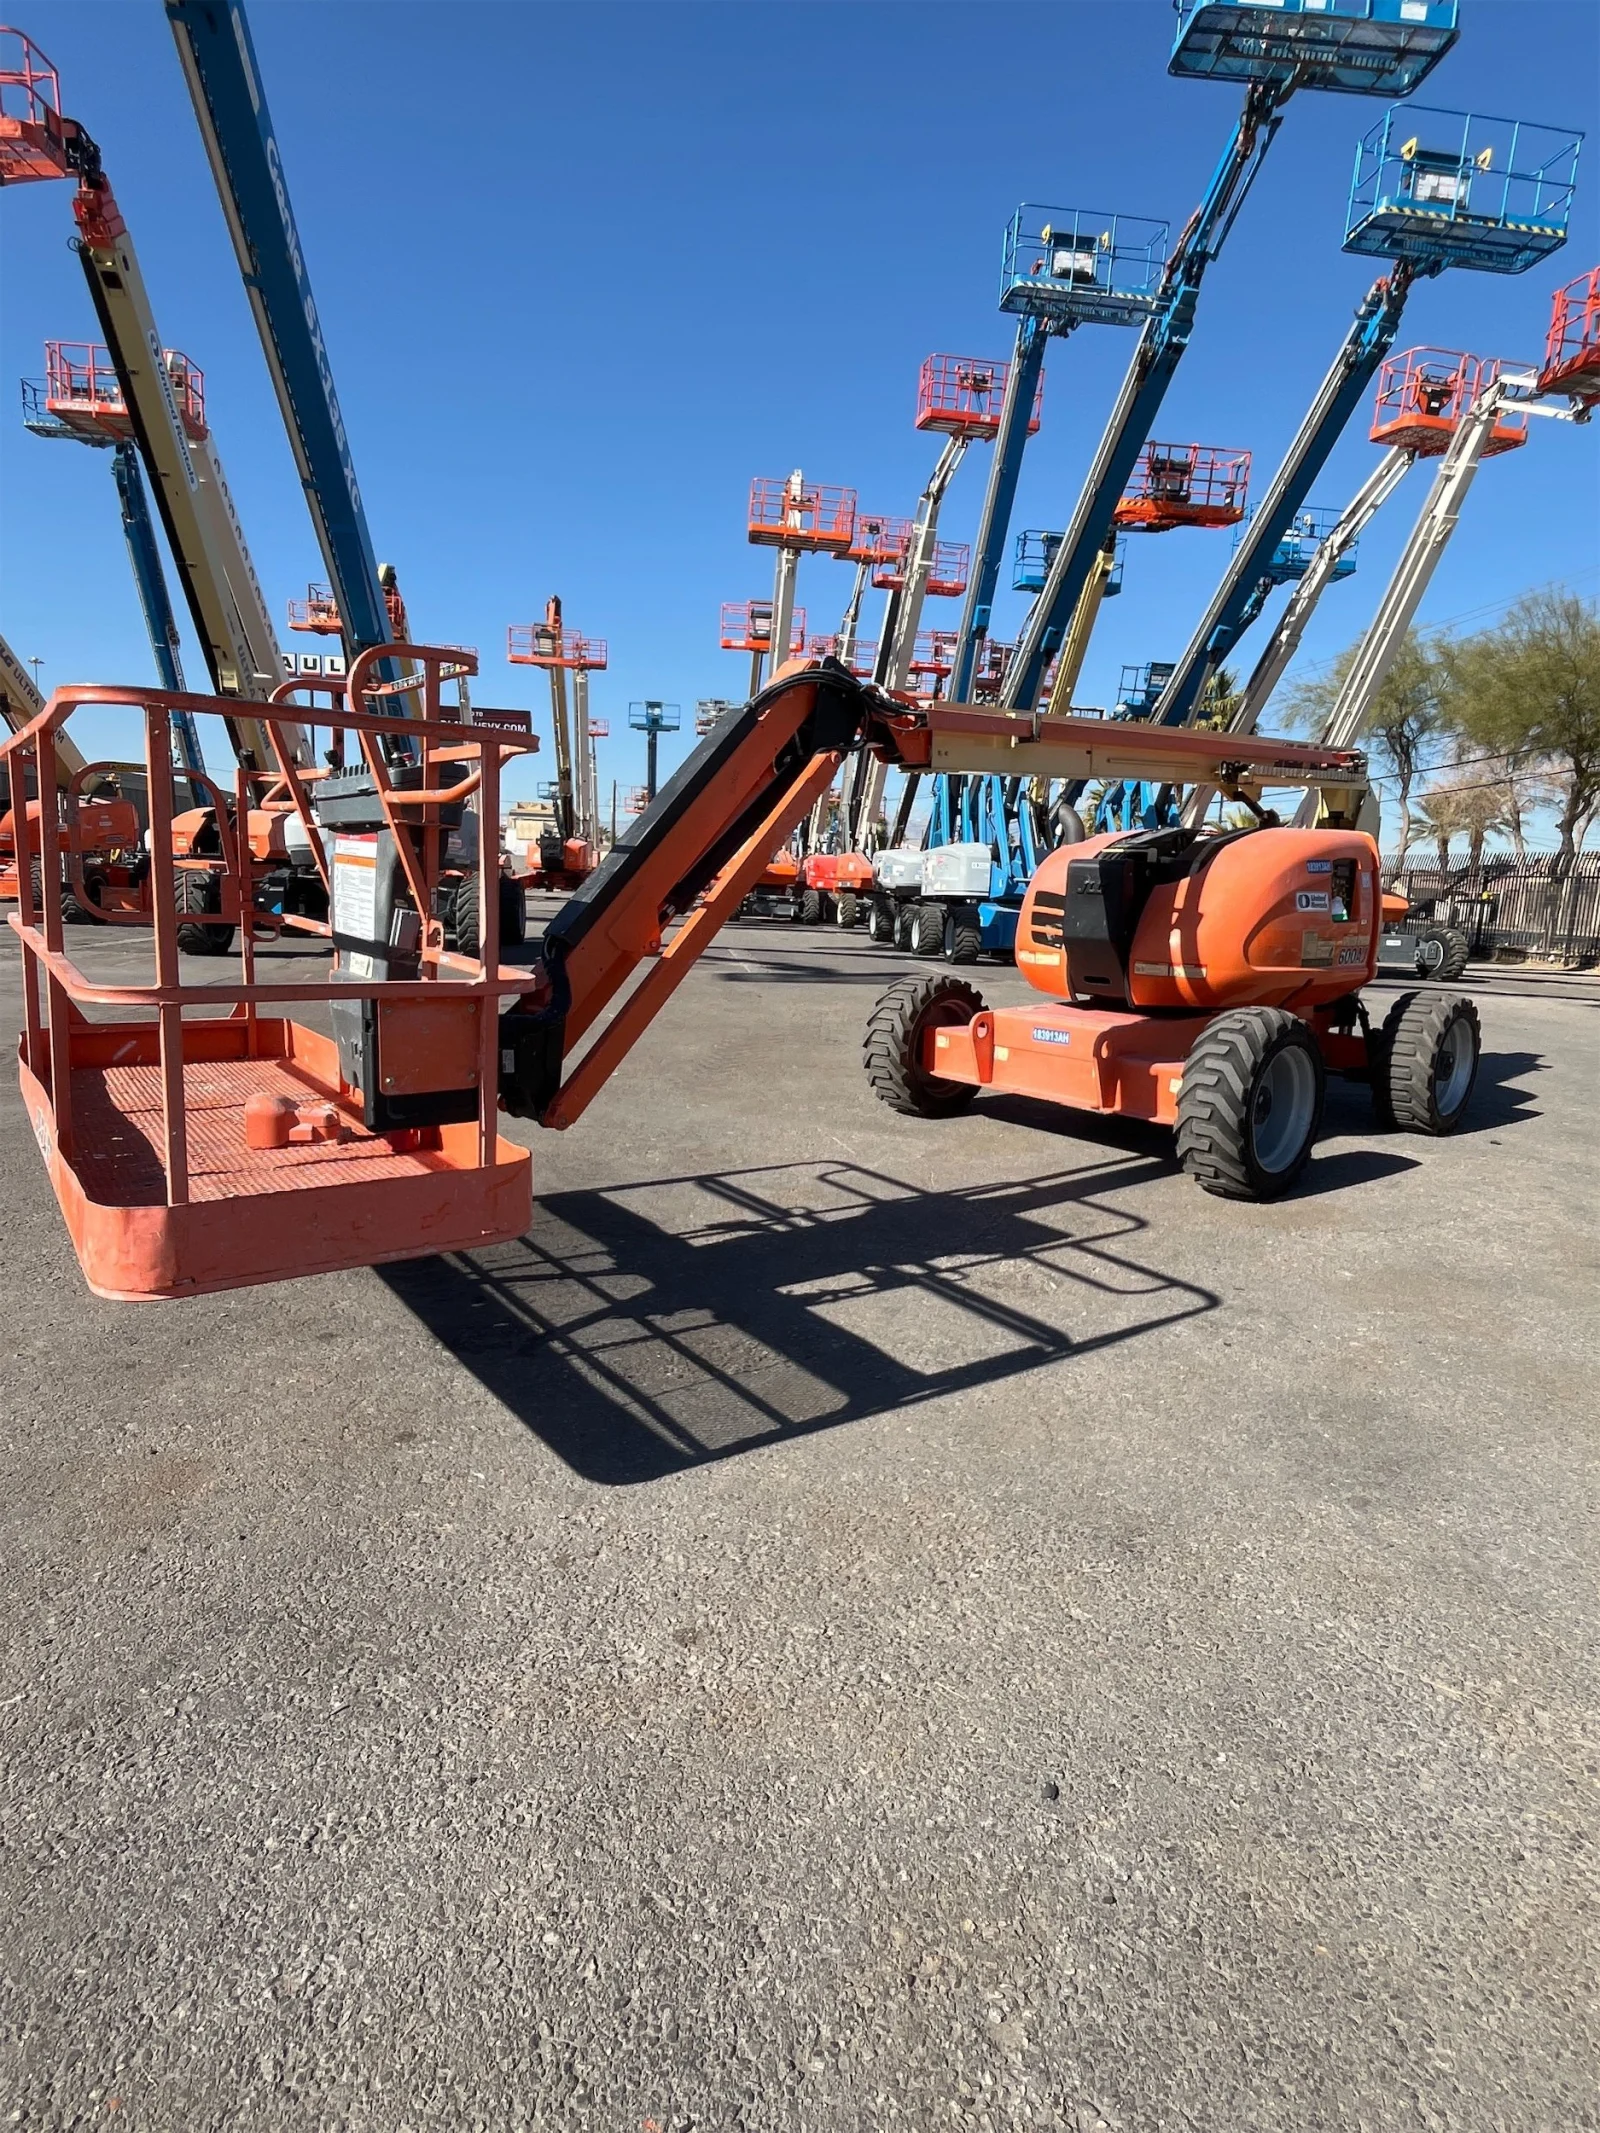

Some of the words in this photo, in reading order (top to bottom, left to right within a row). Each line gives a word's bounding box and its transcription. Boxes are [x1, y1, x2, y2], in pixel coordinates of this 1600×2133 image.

[266, 136, 302, 284] Genie
[158, 362, 178, 419] United
[175, 425, 195, 484] Rentals
[13, 667, 40, 708] ULTRA
